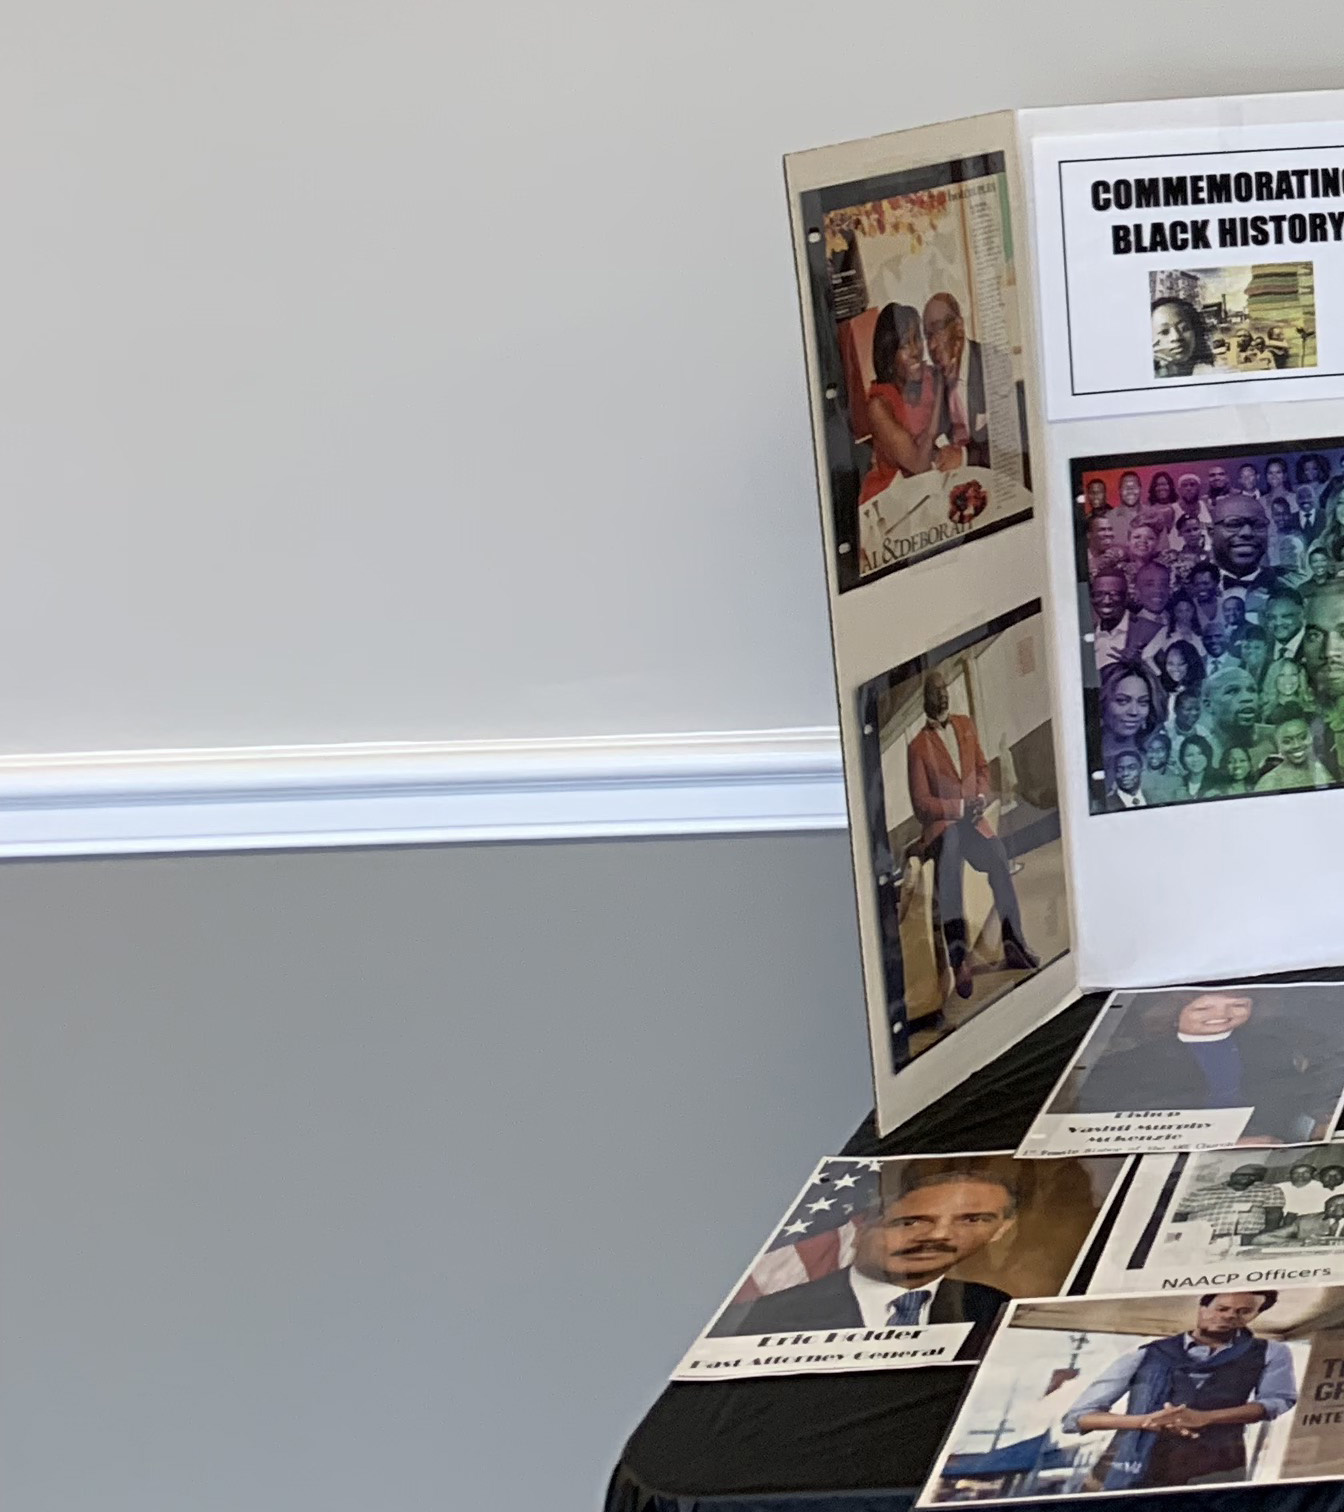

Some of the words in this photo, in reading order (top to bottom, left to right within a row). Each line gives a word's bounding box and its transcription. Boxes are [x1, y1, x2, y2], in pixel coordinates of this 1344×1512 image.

[1111, 219, 1212, 255] BLACK
[1161, 1274, 1240, 1289] NAACP
[1246, 1266, 1332, 1282] Officers
[757, 1331, 817, 1348] Eric
[825, 1328, 931, 1345] Holder
[690, 1359, 741, 1369] Past
[747, 1353, 846, 1367] Attorney
[854, 1346, 946, 1361] General
